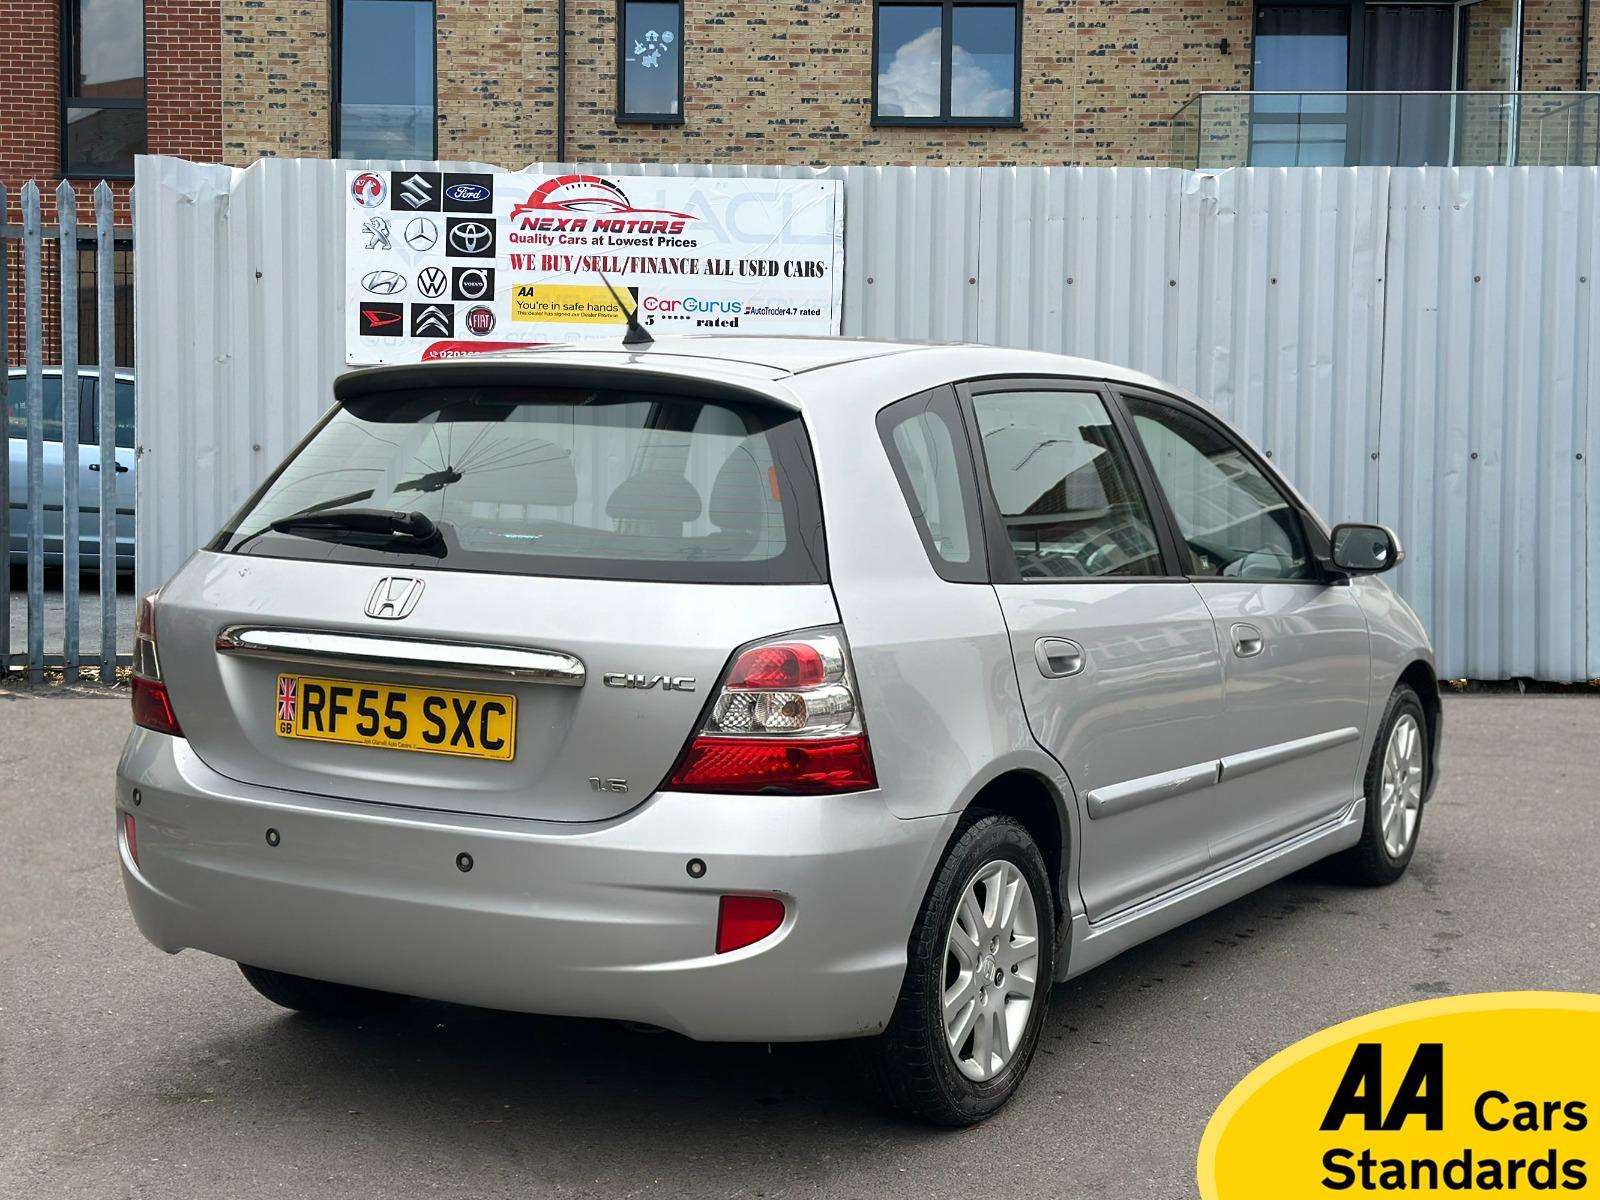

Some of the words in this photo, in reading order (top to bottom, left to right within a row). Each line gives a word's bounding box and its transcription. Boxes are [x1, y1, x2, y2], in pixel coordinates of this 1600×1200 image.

[454, 186, 482, 199] Ford
[520, 217, 588, 232] NEXA
[592, 219, 686, 235] MOTORS
[509, 232, 555, 247] Quality
[558, 234, 588, 245] Cars
[591, 235, 604, 246] at
[608, 235, 654, 247] Lowest
[657, 236, 698, 248] Prices
[509, 253, 536, 271] WE
[704, 259, 734, 276] ALL
[739, 260, 780, 277] USED
[783, 260, 825, 279] CARS
[517, 286, 535, 297] AA
[516, 300, 549, 311] You're
[552, 301, 561, 311] in
[563, 301, 585, 312] safe
[588, 302, 619, 313] hands
[643, 296, 743, 314] CarGurus
[800, 308, 821, 316] rated
[473, 314, 490, 328] FIAT
[645, 314, 655, 326] 5
[696, 317, 739, 328] rated
[603, 672, 696, 692] CIVIC
[302, 683, 408, 740] RF55
[422, 695, 507, 751] SXC
[280, 722, 292, 735] GB
